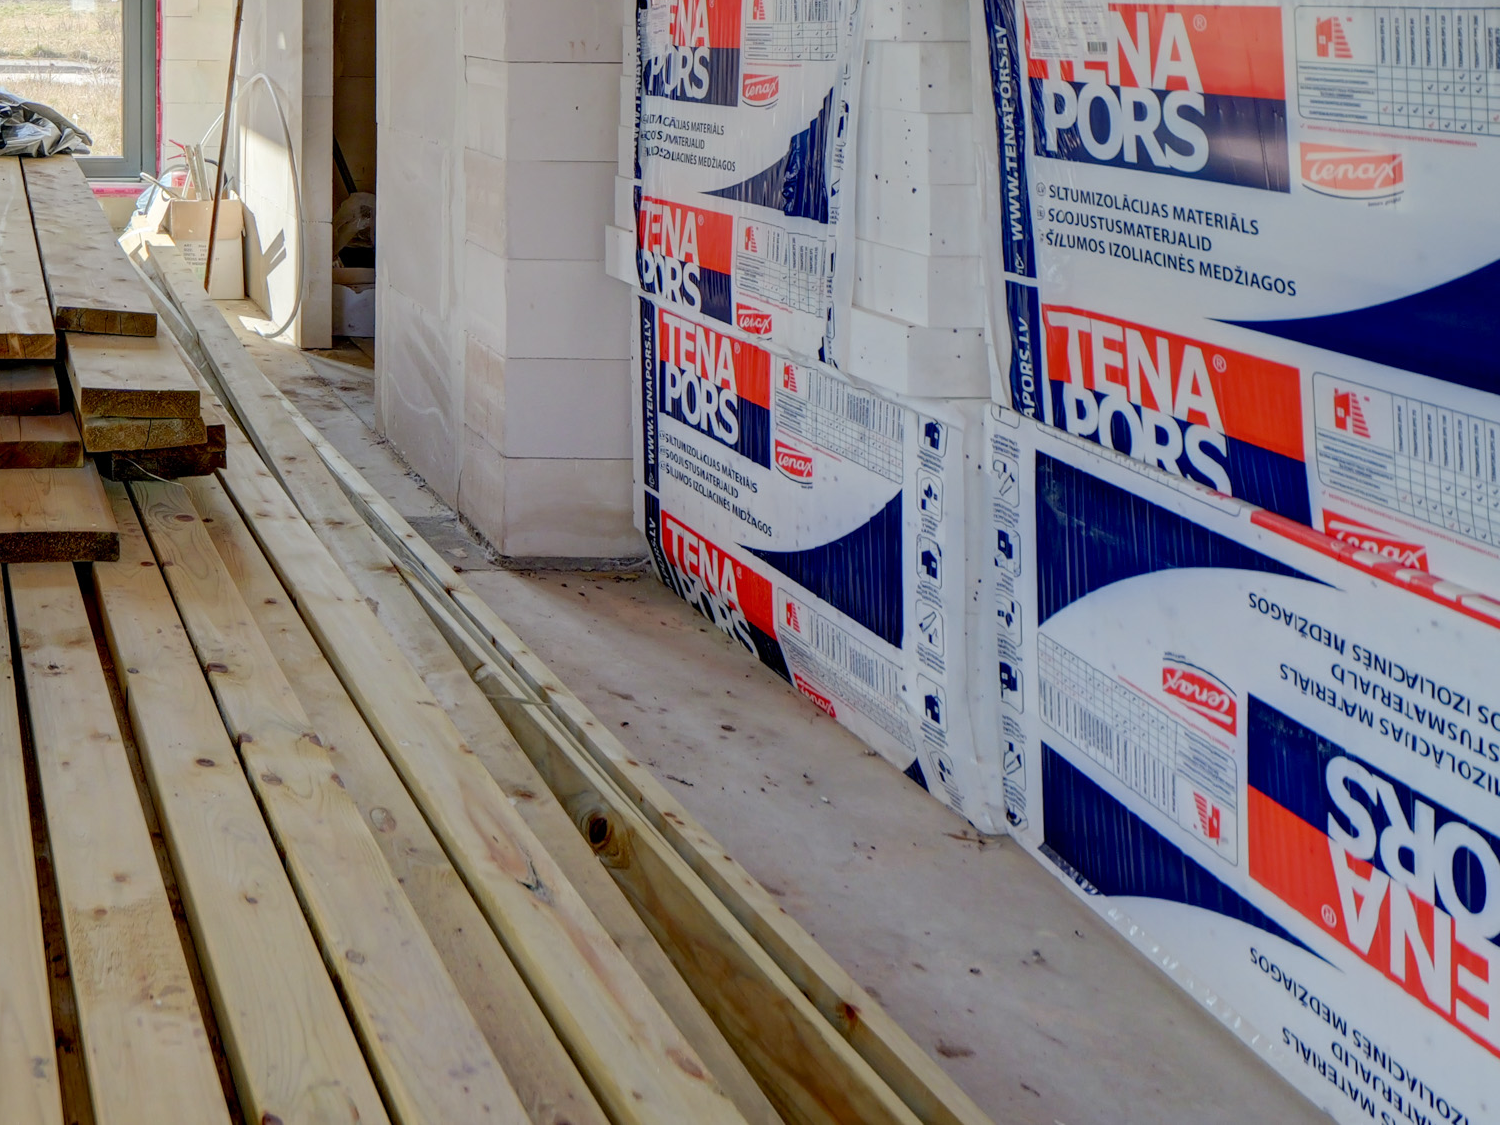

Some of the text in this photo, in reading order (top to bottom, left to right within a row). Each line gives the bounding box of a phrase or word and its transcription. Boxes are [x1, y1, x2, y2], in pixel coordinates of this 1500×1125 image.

[994, 24, 1025, 241] WWW.TENAPORS.LV
[1043, 81, 1209, 173] PORS
[1173, 205, 1260, 236] MATERIĀLS
[1108, 240, 1196, 274] IZOLIACINĖS
[1199, 261, 1297, 296] MEDŽIAGOS
[643, 318, 656, 465] WWW.TENAPORS.LV
[662, 311, 738, 395] TENA
[1046, 310, 1228, 437] TENA
[665, 365, 740, 445] PORS
[666, 517, 741, 611] TENA
[1326, 756, 1500, 939] ORS
[1328, 837, 1500, 1029] ENA
[1250, 946, 1347, 1038] MEDŽIAGOS
[1282, 1027, 1376, 1118] MATERIĀLS
